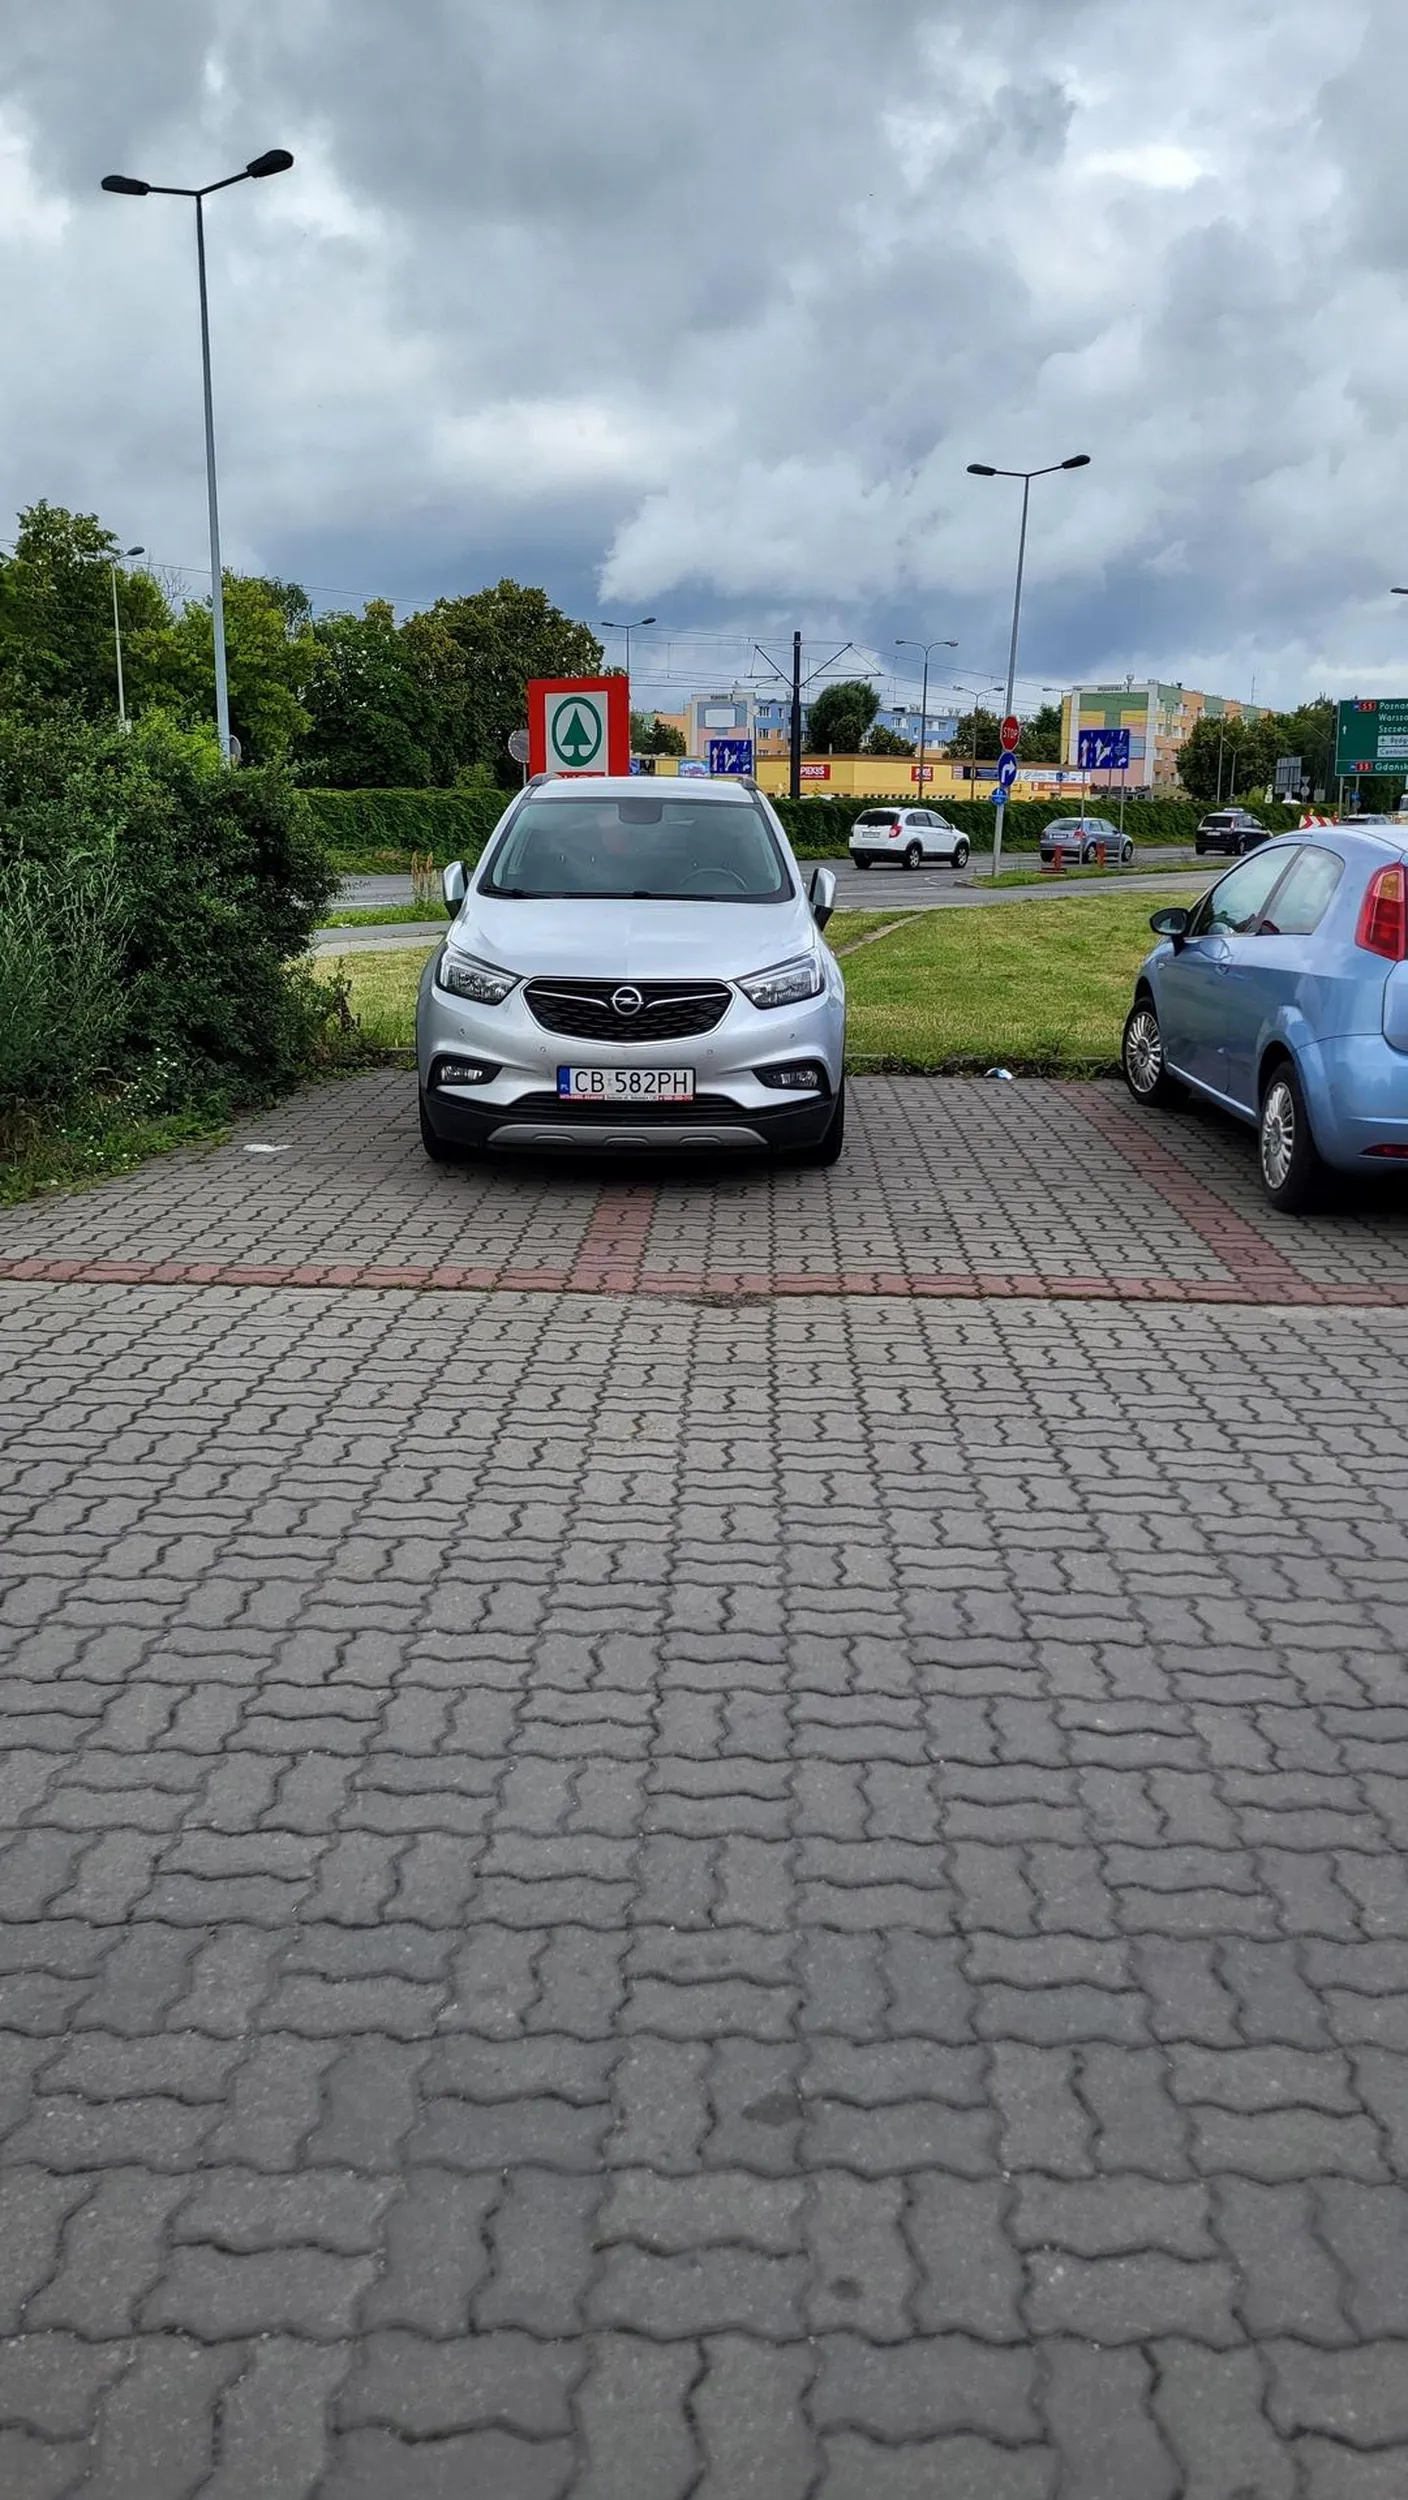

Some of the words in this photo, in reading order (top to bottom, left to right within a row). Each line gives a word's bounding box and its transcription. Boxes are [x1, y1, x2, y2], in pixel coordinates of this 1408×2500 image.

[1003, 727, 1018, 739] STOP
[575, 1071, 604, 1093] CB
[615, 1072, 688, 1094] 582PH
